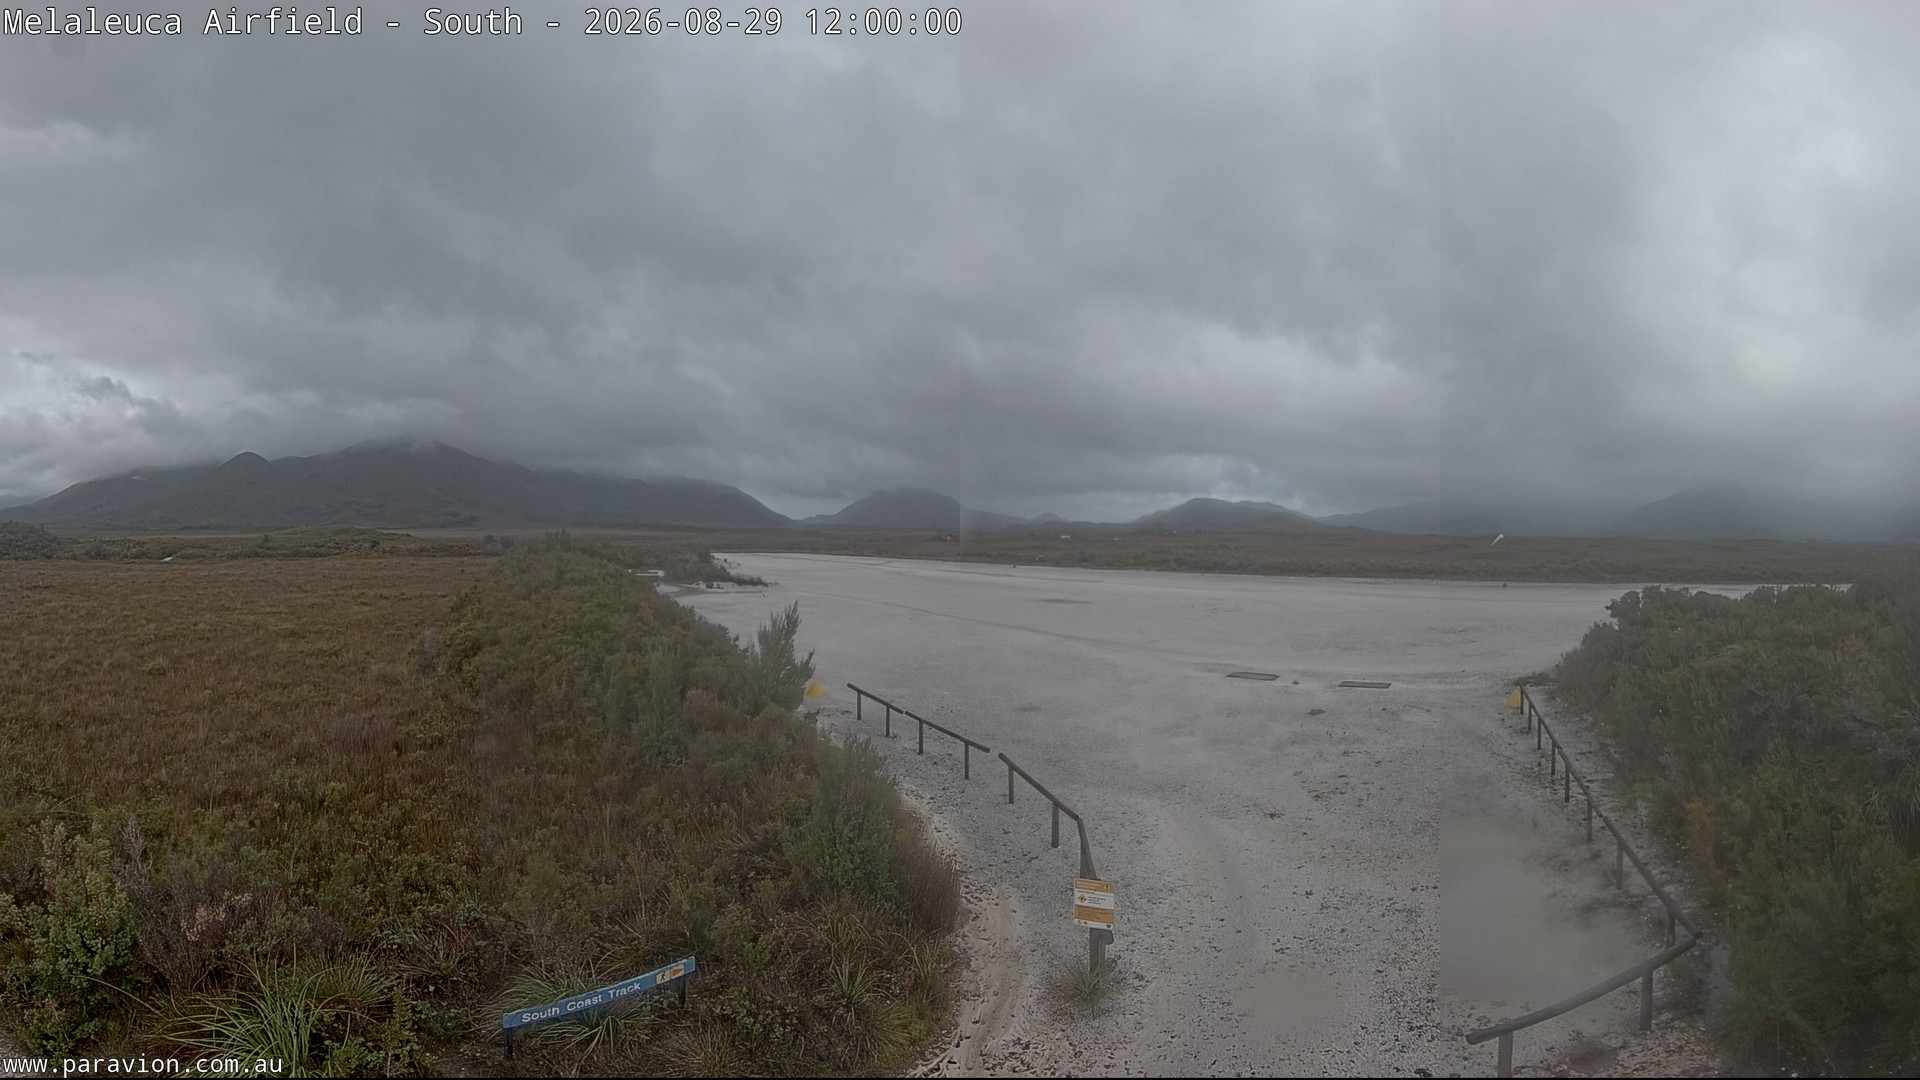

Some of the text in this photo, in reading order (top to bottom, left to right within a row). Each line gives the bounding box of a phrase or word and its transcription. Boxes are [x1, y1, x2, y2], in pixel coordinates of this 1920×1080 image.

[521, 982, 642, 1023] South Coast Track
